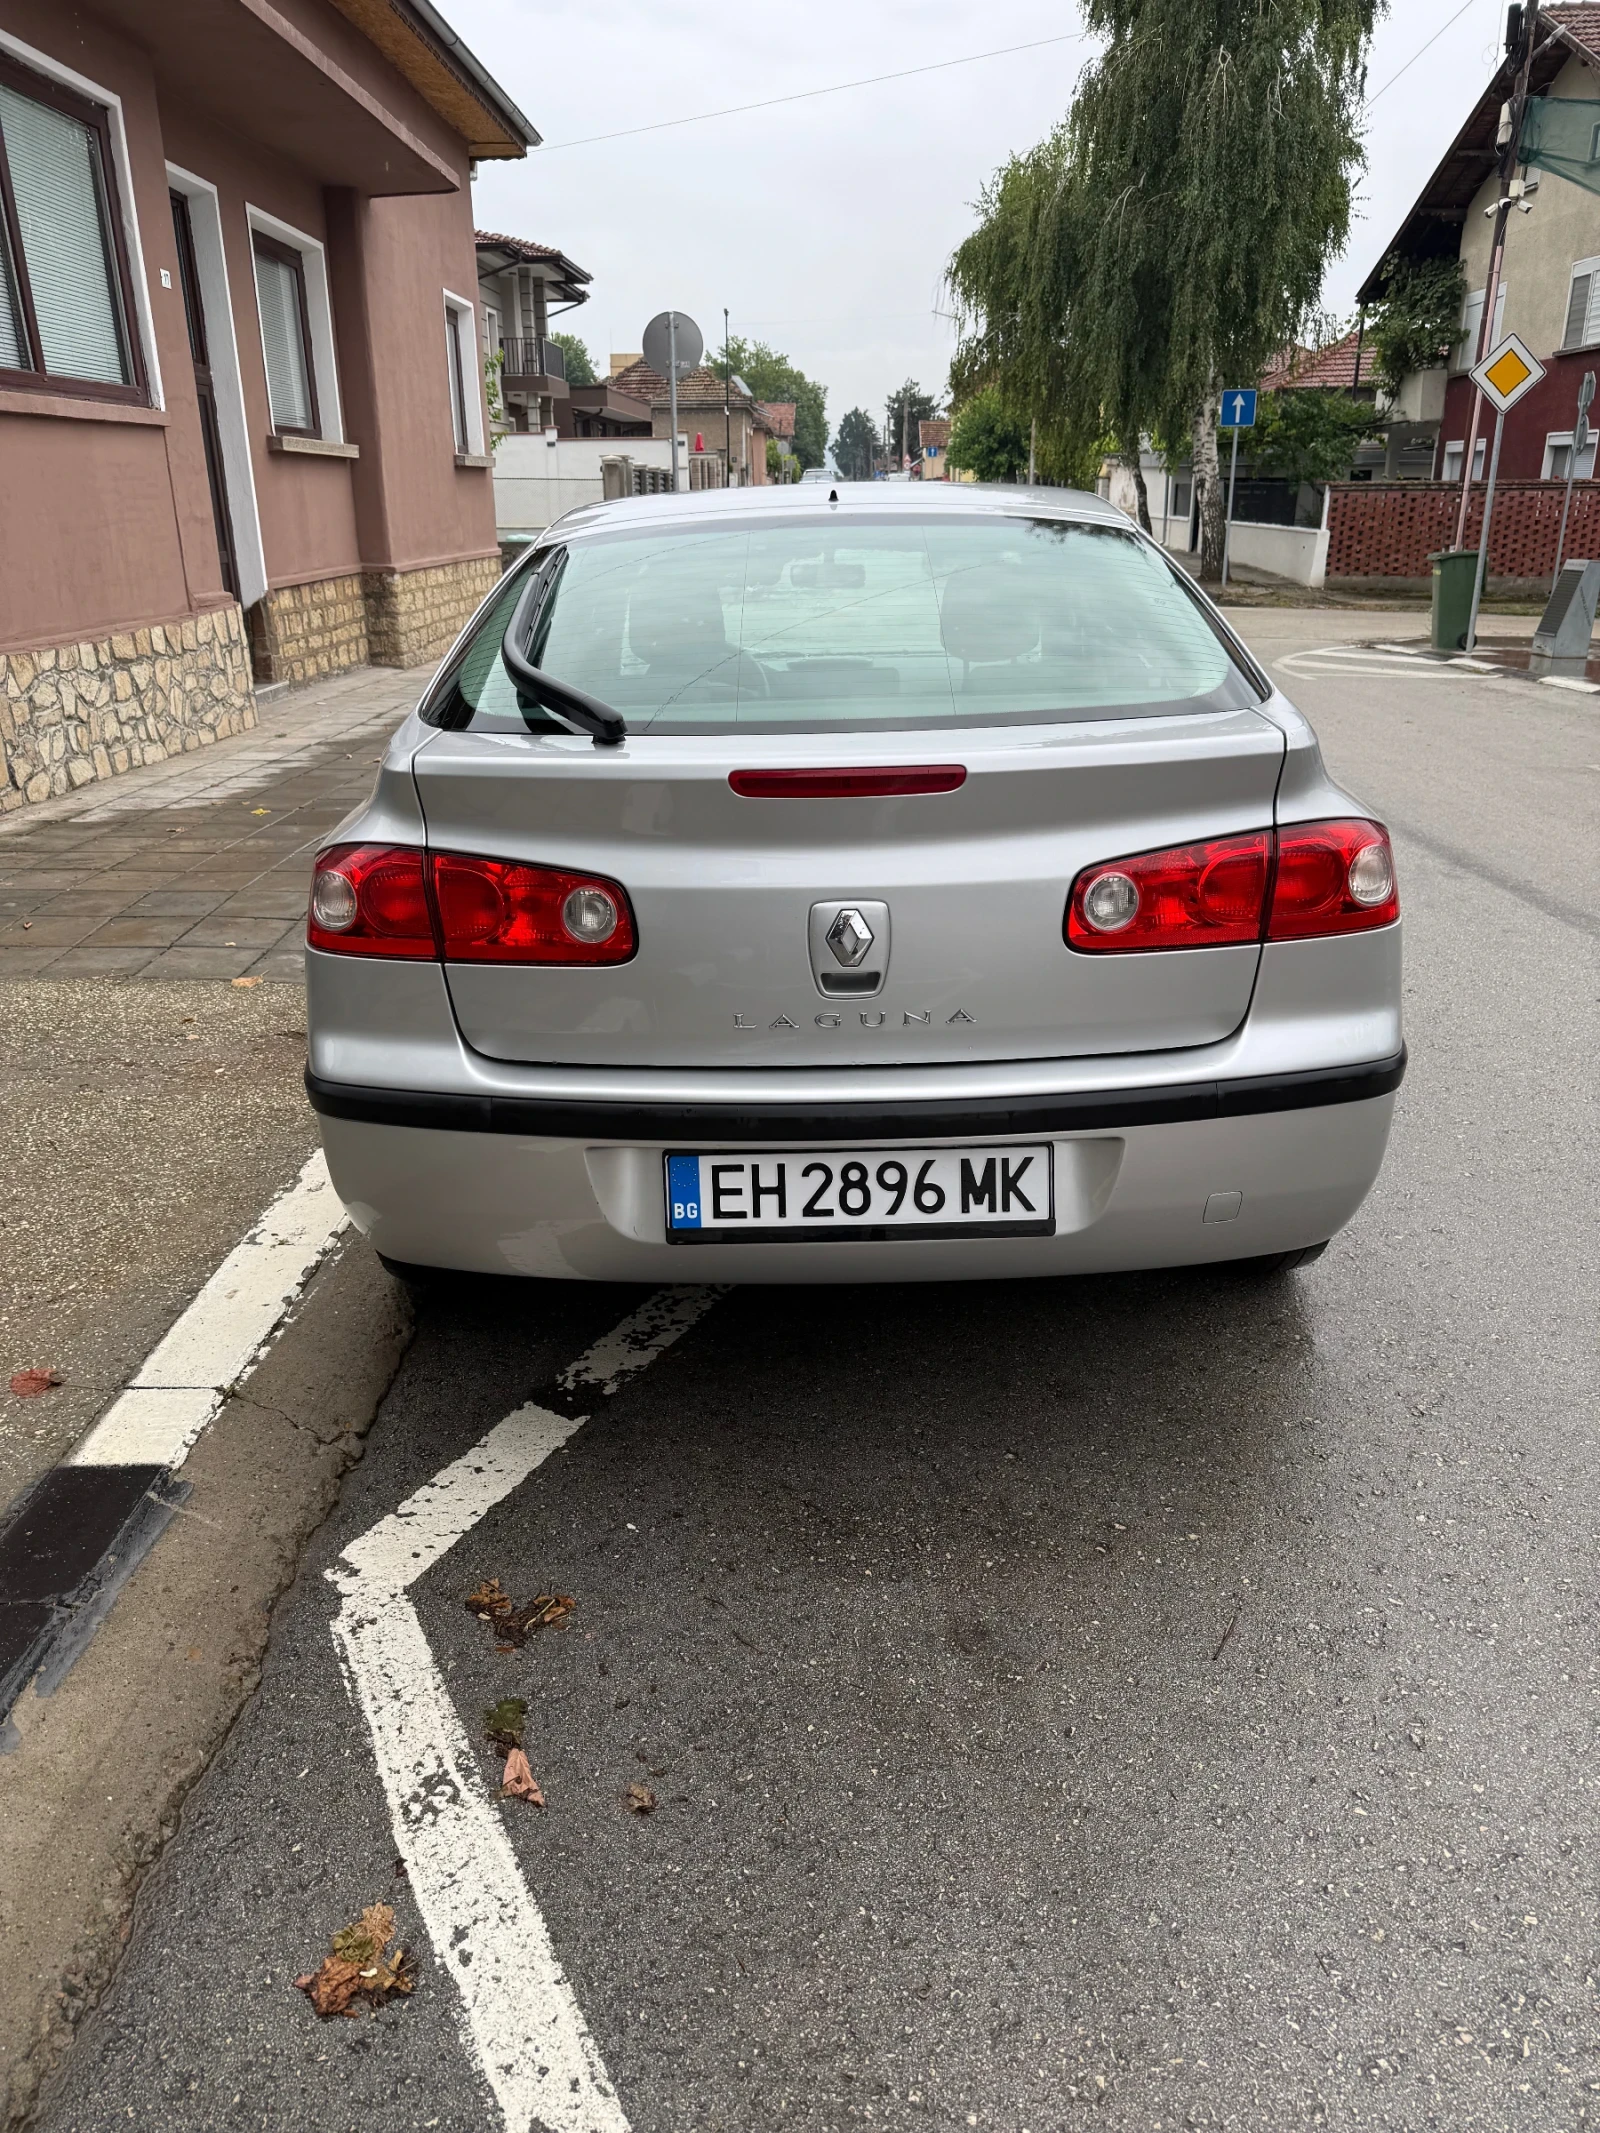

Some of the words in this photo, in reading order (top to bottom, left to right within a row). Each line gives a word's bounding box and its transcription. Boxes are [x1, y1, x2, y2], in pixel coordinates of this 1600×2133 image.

[733, 1008, 977, 1029] LAGUNA
[711, 1162, 786, 1219] EH
[801, 1160, 946, 1218] 2896
[960, 1157, 1037, 1214] MK
[674, 1202, 698, 1220] BG
